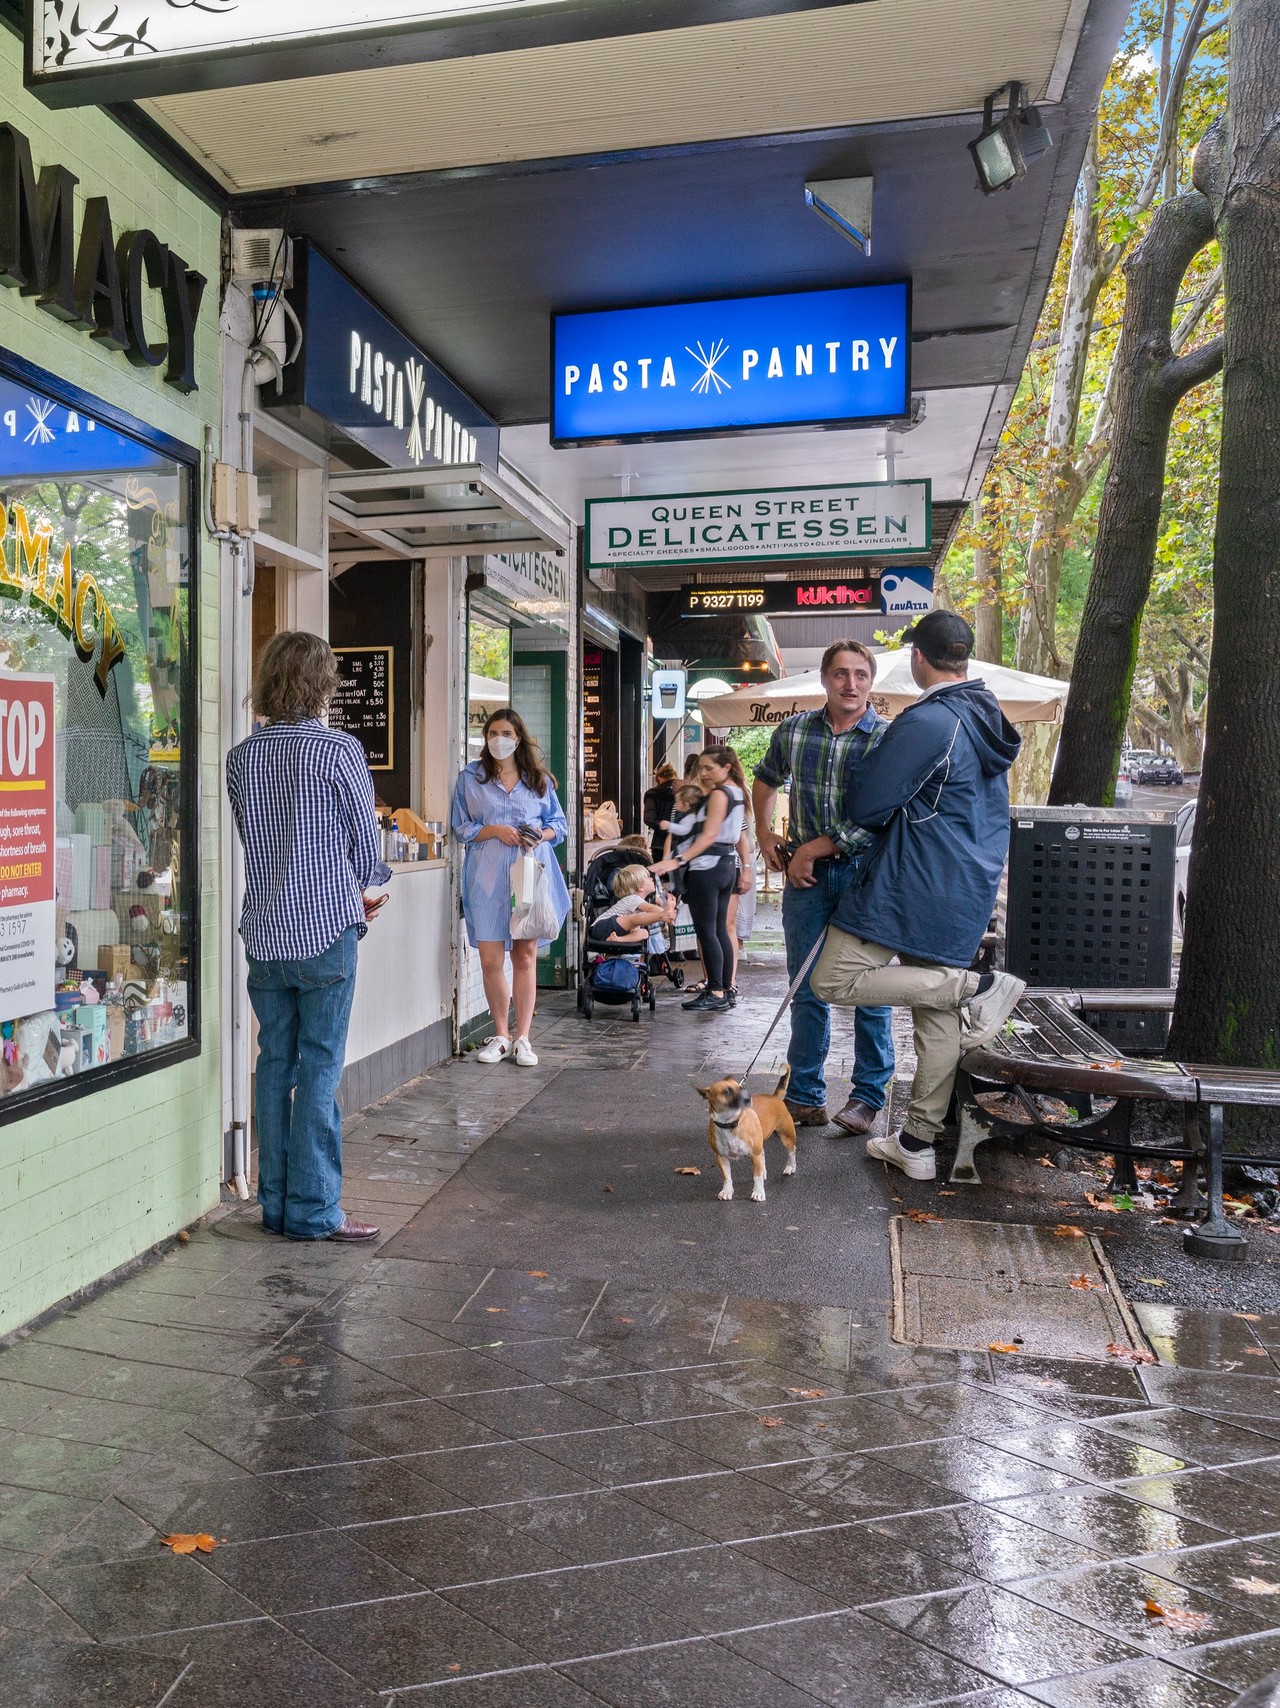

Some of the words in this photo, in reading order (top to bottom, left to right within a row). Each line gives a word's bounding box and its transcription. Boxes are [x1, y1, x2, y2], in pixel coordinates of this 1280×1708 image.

[565, 356, 676, 395] PASTA
[742, 336, 898, 381] PANTRY
[349, 330, 403, 429] PASTA
[651, 504, 742, 524] QUEEN
[754, 497, 860, 517] STREET
[607, 515, 910, 549] DELICATESSEN
[656, 547, 694, 555] CHEESES
[690, 596, 699, 608] P
[703, 595, 734, 608] 9327
[737, 594, 764, 607] 1199
[890, 600, 929, 611] LAVAZZA
[11, 807, 28, 818] following
[12, 826, 24, 837] sore
[24, 843, 30, 855] of
[30, 841, 47, 853] breath
[0, 866, 10, 878] DO
[11, 864, 23, 877] NOT
[23, 862, 42, 875] ENTER
[1, 885, 28, 901] pharmacy.
[8, 920, 27, 936] 1597
